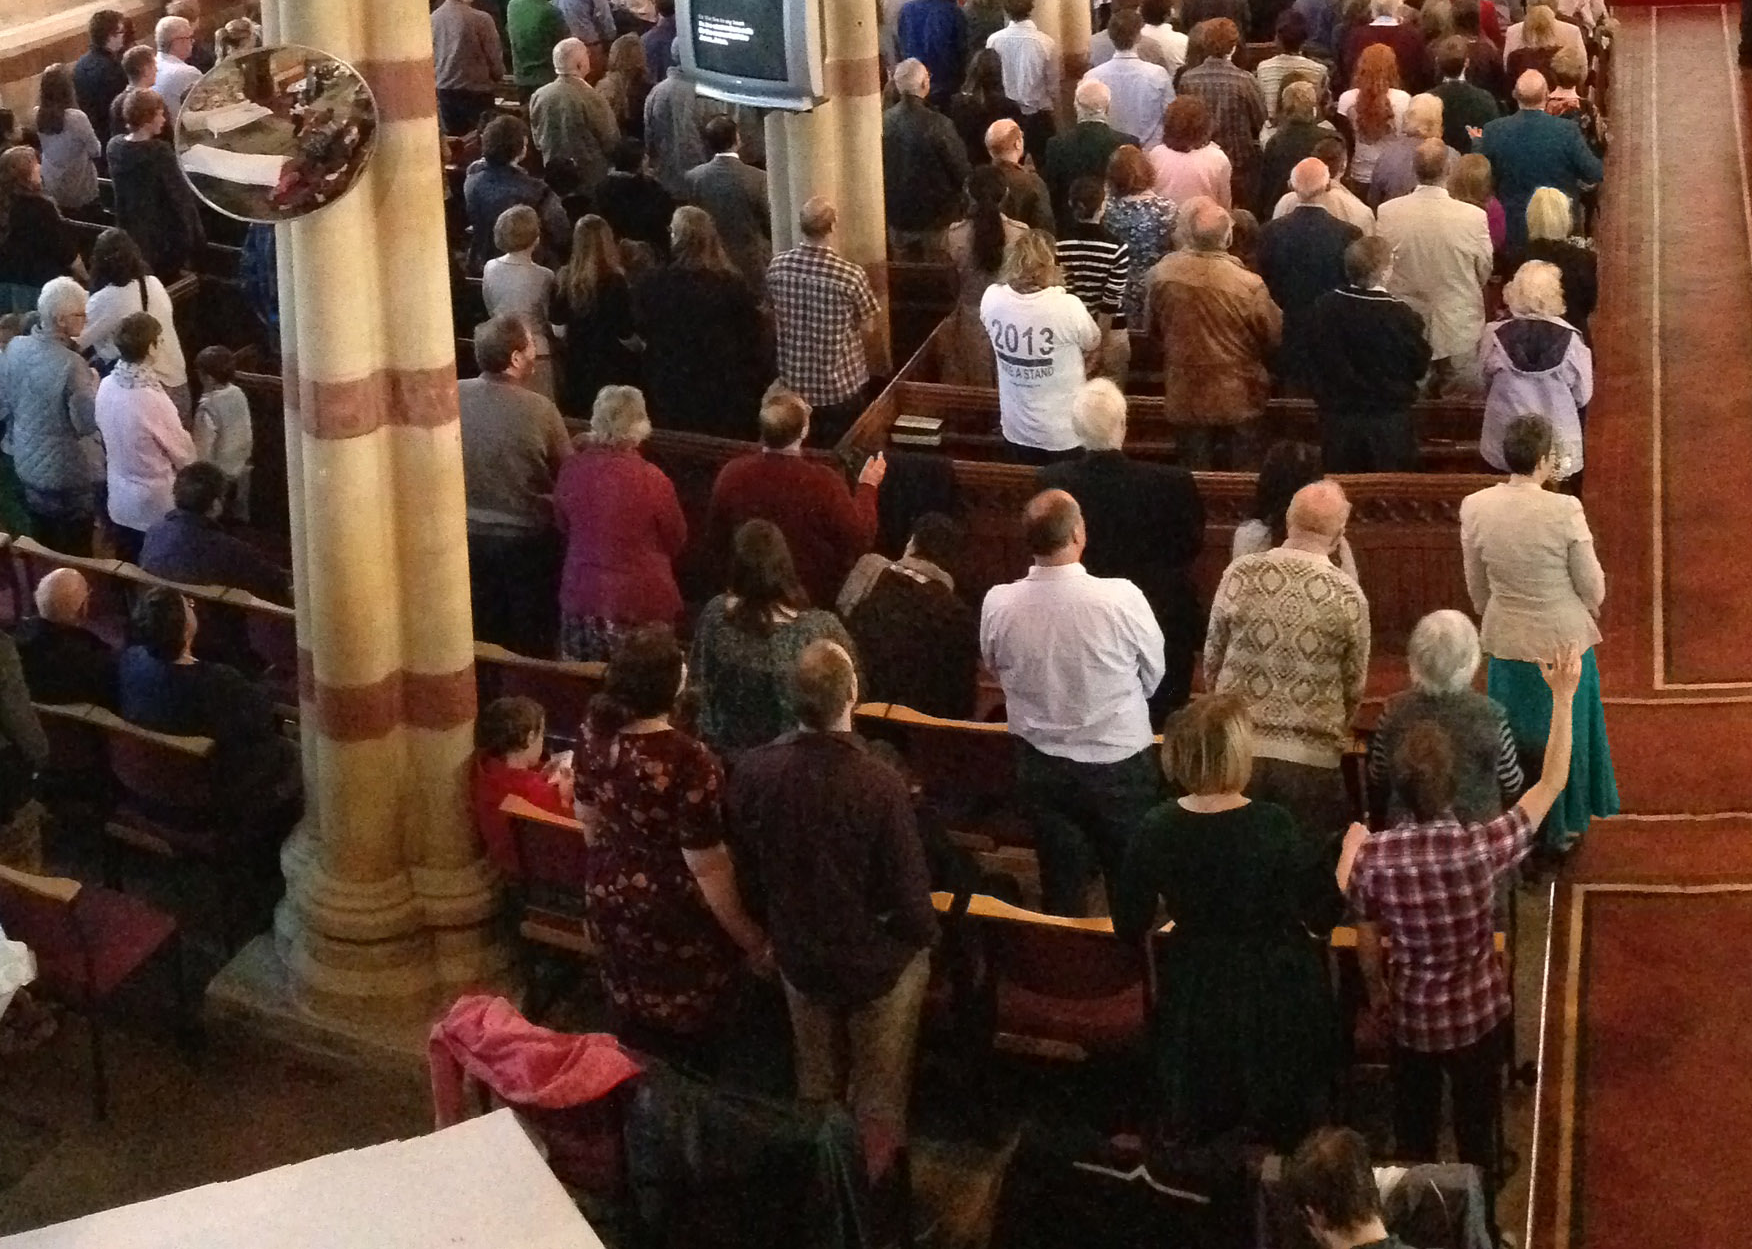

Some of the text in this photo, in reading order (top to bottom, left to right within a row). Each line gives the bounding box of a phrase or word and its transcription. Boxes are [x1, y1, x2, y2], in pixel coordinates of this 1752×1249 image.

[992, 319, 1054, 356] 2013
[1015, 367, 1023, 378] A
[1024, 366, 1054, 380] STAND
